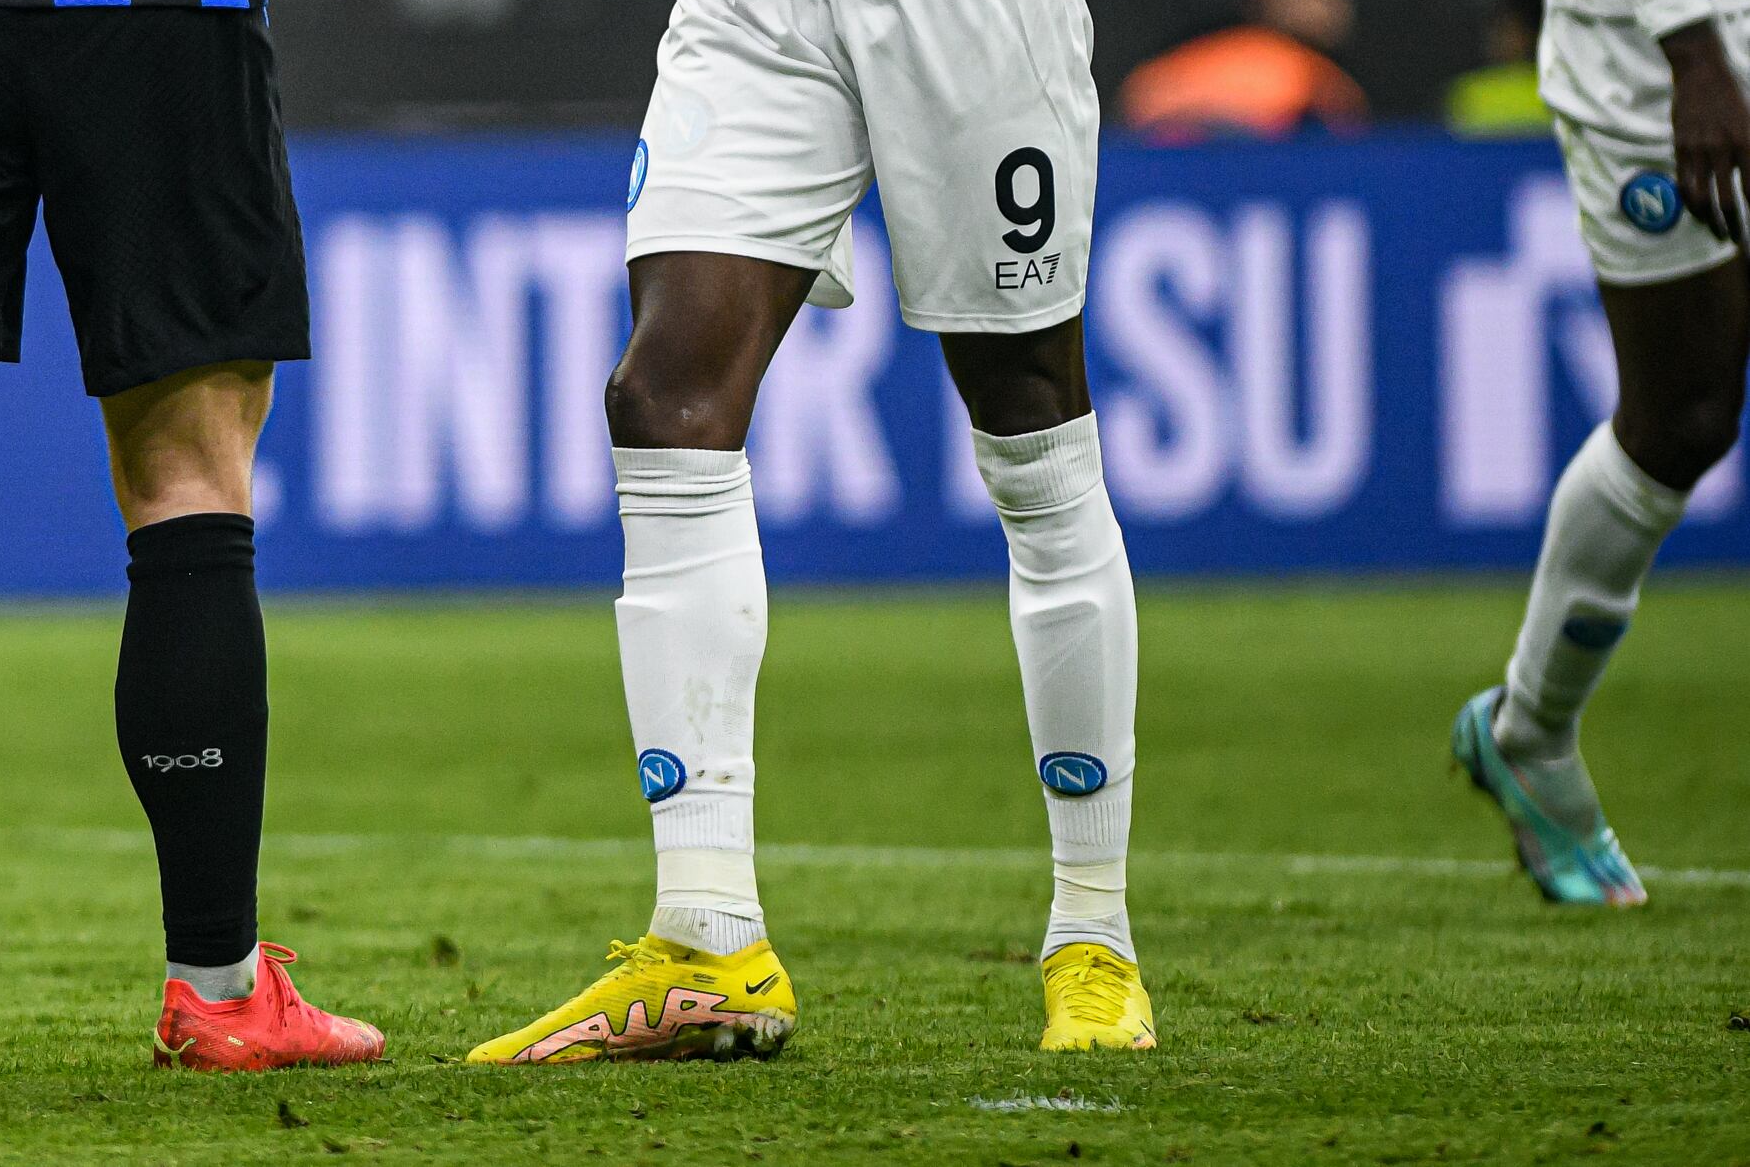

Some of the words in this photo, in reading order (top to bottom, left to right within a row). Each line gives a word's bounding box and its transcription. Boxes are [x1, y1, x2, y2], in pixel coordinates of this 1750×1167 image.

[995, 147, 1056, 254] 9
[995, 252, 1062, 290] EA7
[314, 212, 903, 531] INTR
[141, 747, 224, 773] 1908
